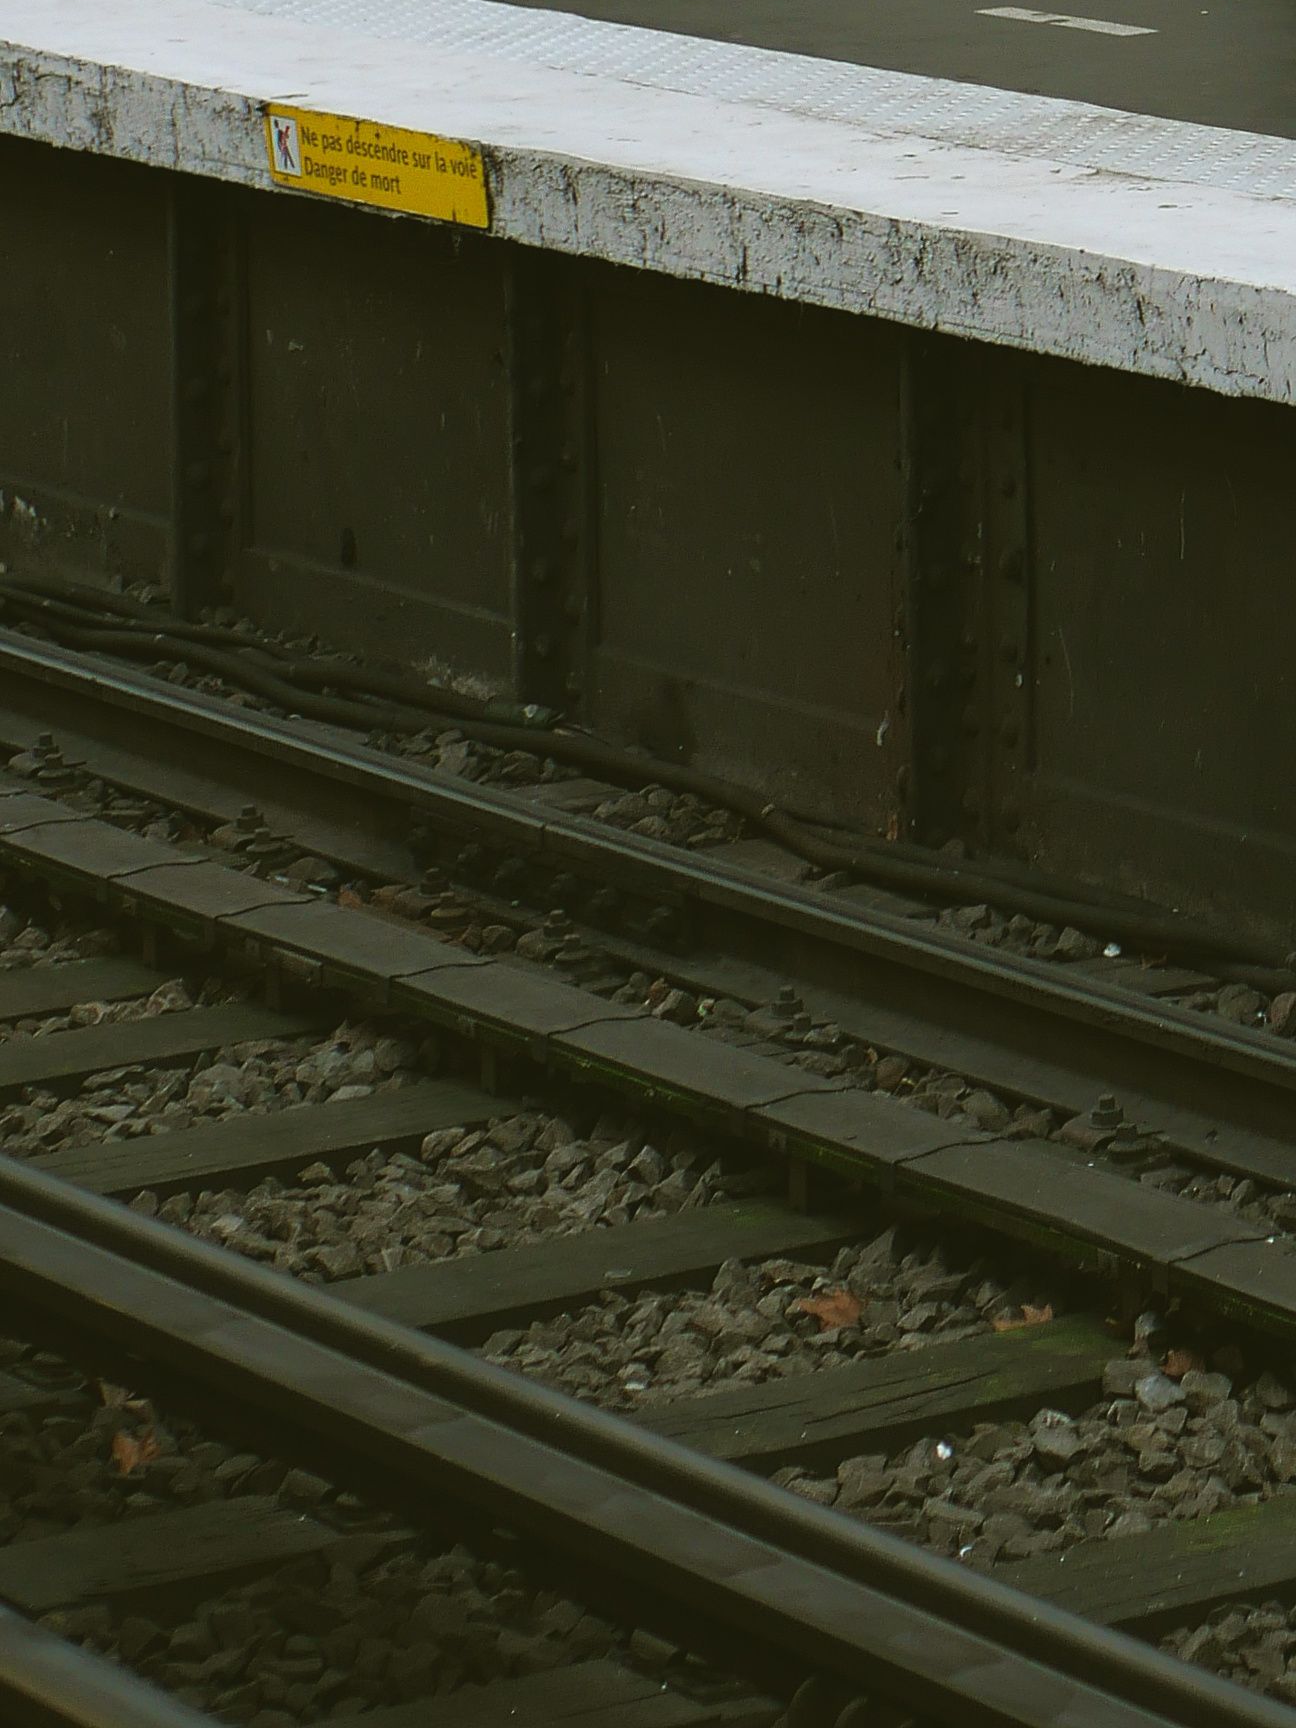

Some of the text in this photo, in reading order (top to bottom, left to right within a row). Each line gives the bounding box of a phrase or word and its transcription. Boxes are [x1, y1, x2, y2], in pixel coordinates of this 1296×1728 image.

[302, 126, 477, 179] Ne pas descendre sur la voie
[304, 156, 401, 194] Danger de mort
